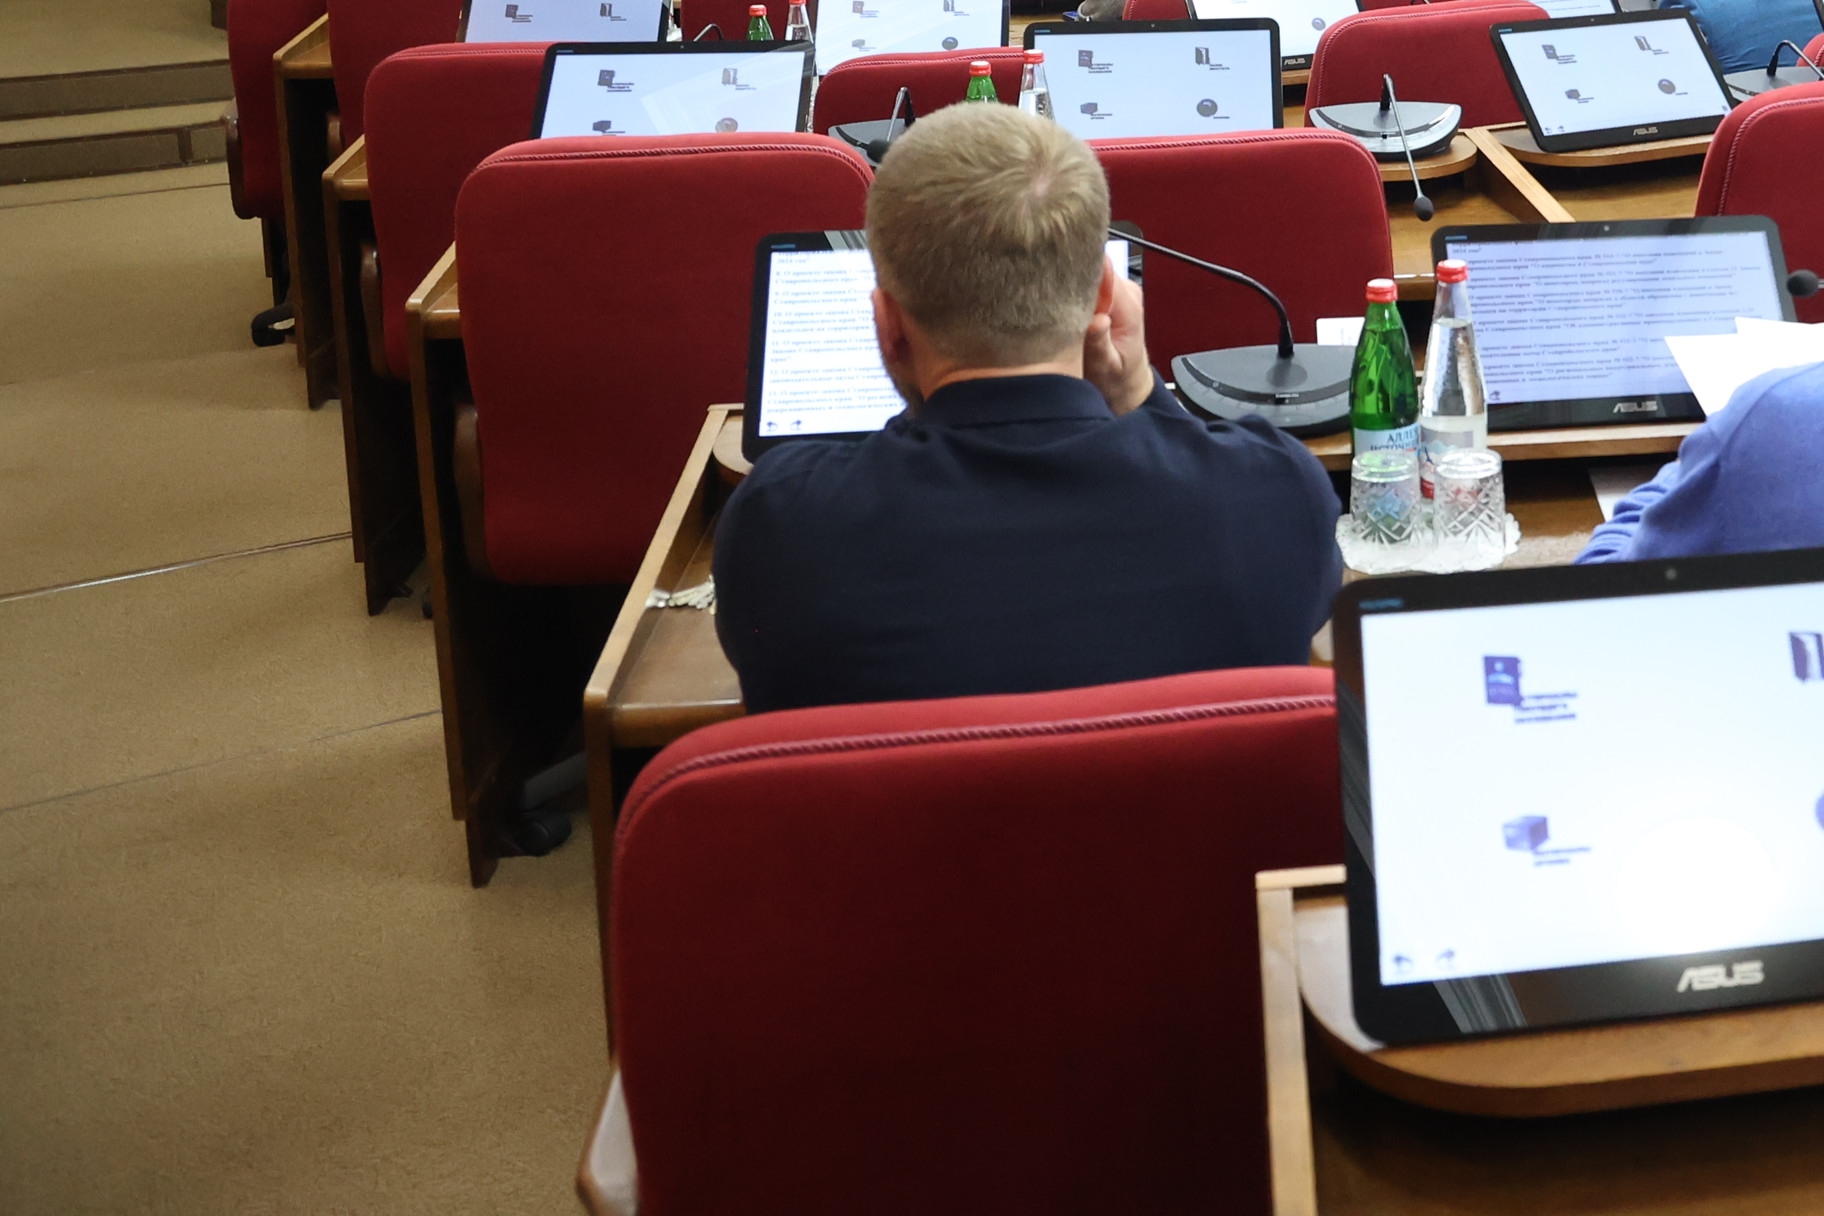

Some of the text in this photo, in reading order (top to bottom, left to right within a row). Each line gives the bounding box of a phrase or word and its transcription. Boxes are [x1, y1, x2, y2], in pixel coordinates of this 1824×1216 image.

[1633, 126, 1659, 136] ASUS
[1612, 400, 1659, 414] ASUS
[1676, 960, 1765, 993] ASUS
